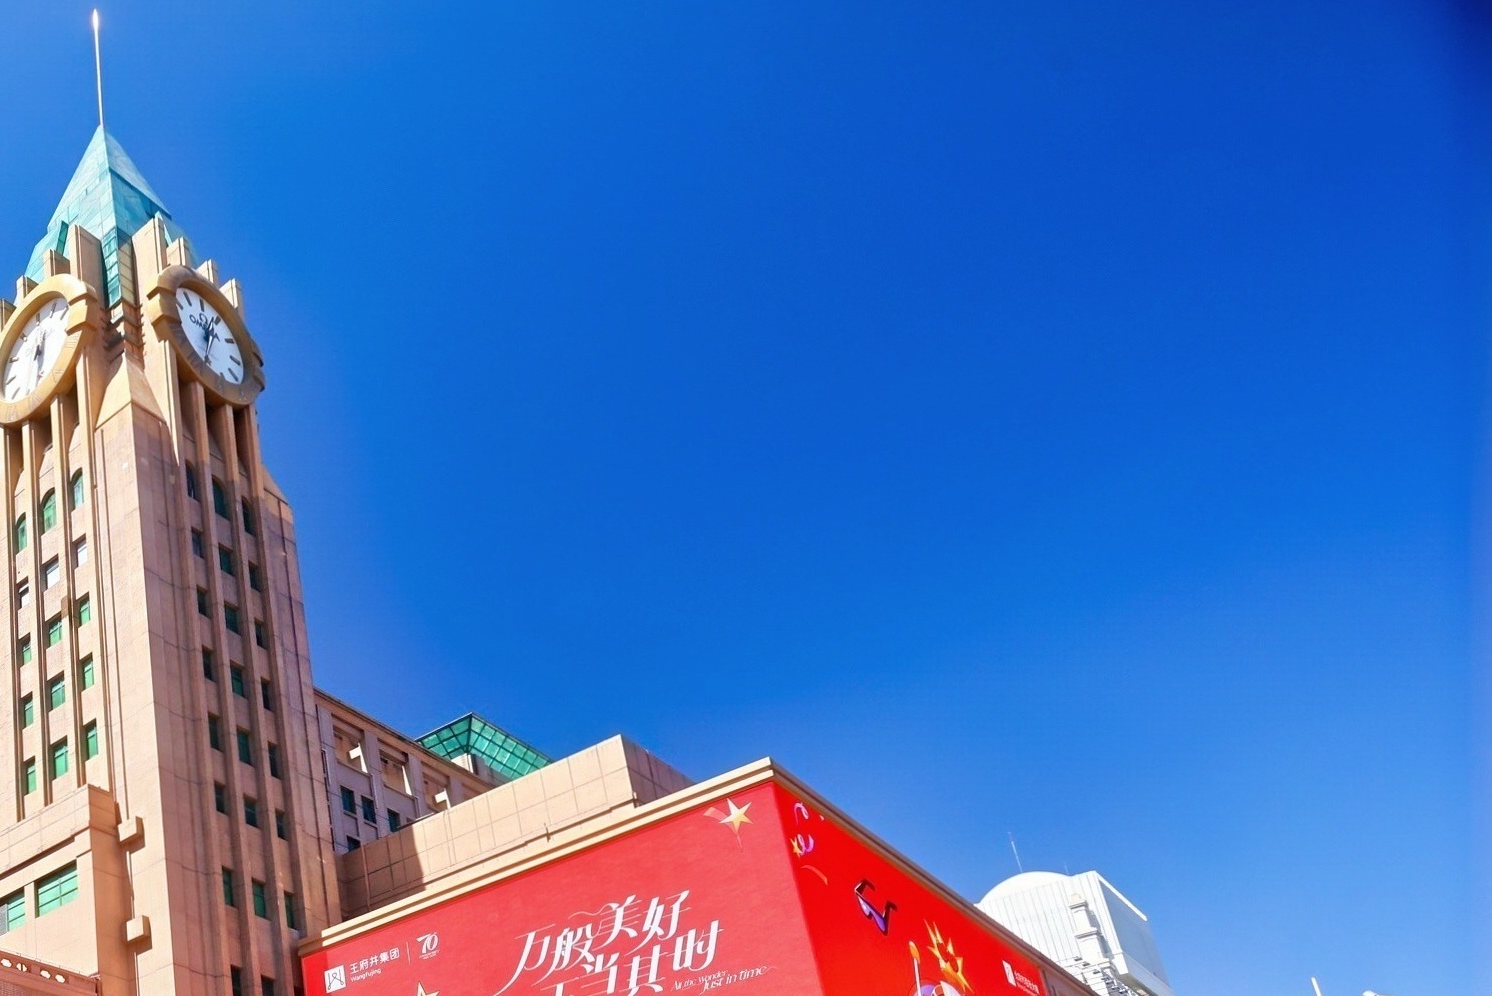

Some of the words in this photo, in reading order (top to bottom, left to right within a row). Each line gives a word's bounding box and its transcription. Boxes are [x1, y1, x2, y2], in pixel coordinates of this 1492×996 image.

[416, 932, 439, 954] 70
[349, 947, 400, 975] 王府井集团
[350, 968, 382, 983] Wangfujing
